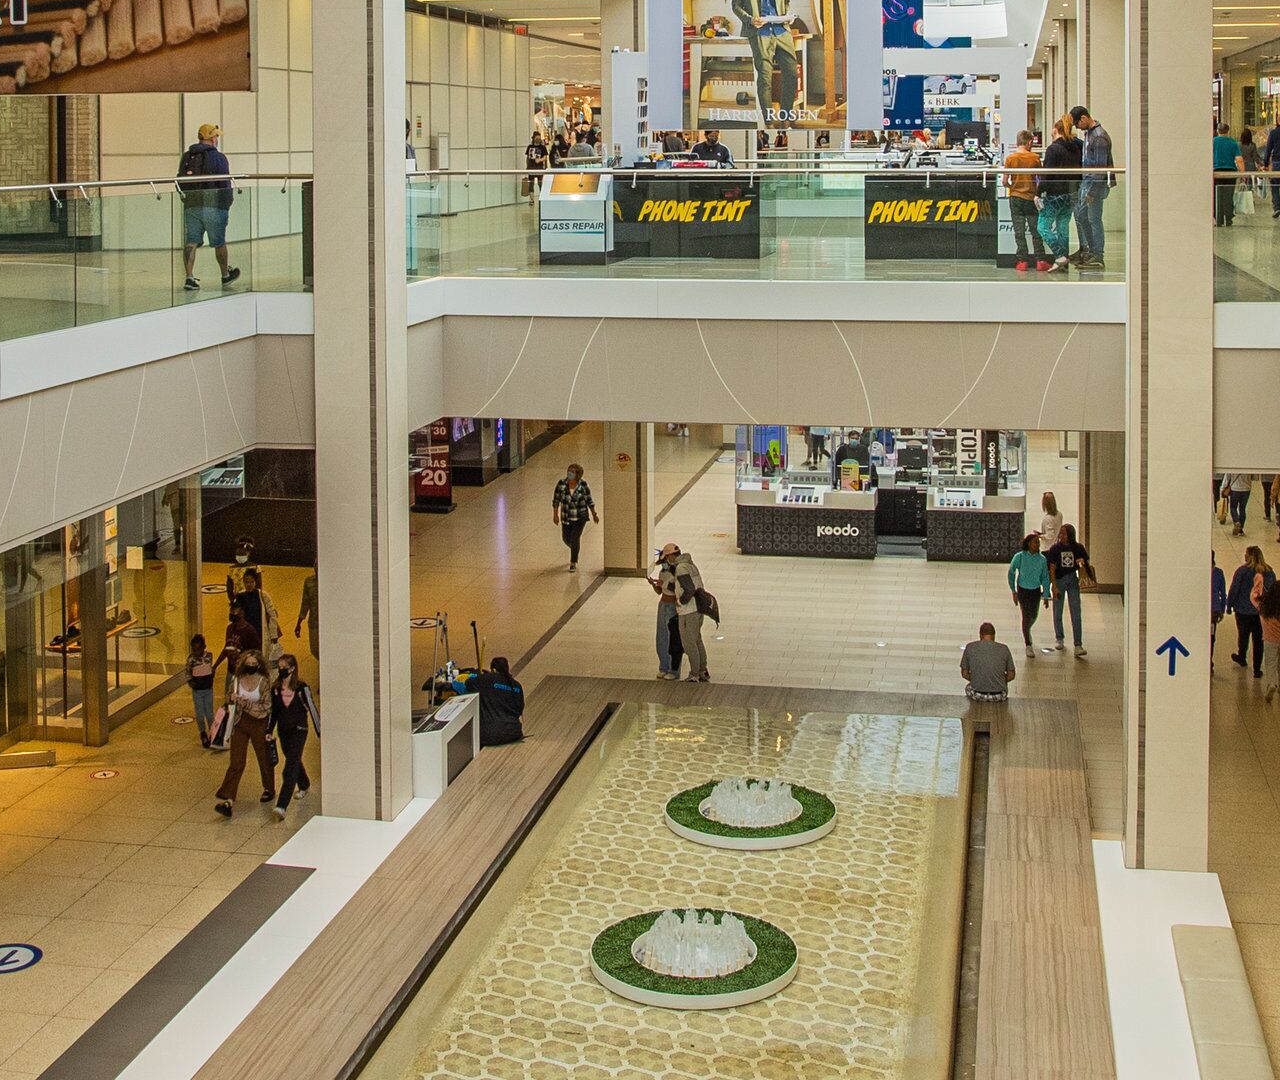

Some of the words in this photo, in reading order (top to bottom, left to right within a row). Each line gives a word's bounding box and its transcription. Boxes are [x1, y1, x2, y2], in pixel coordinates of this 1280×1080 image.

[935, 97, 960, 106] BERK
[708, 108, 762, 121] HARRY
[766, 107, 819, 121] ROSEN
[638, 200, 698, 222] PHONE
[701, 200, 751, 222] TINT
[868, 200, 933, 223] PHONE
[540, 223, 570, 231] GLASS
[571, 222, 604, 231] REPAIR
[987, 441, 997, 469] koodo
[420, 460, 447, 468] BRAS
[816, 524, 859, 537] koodo
